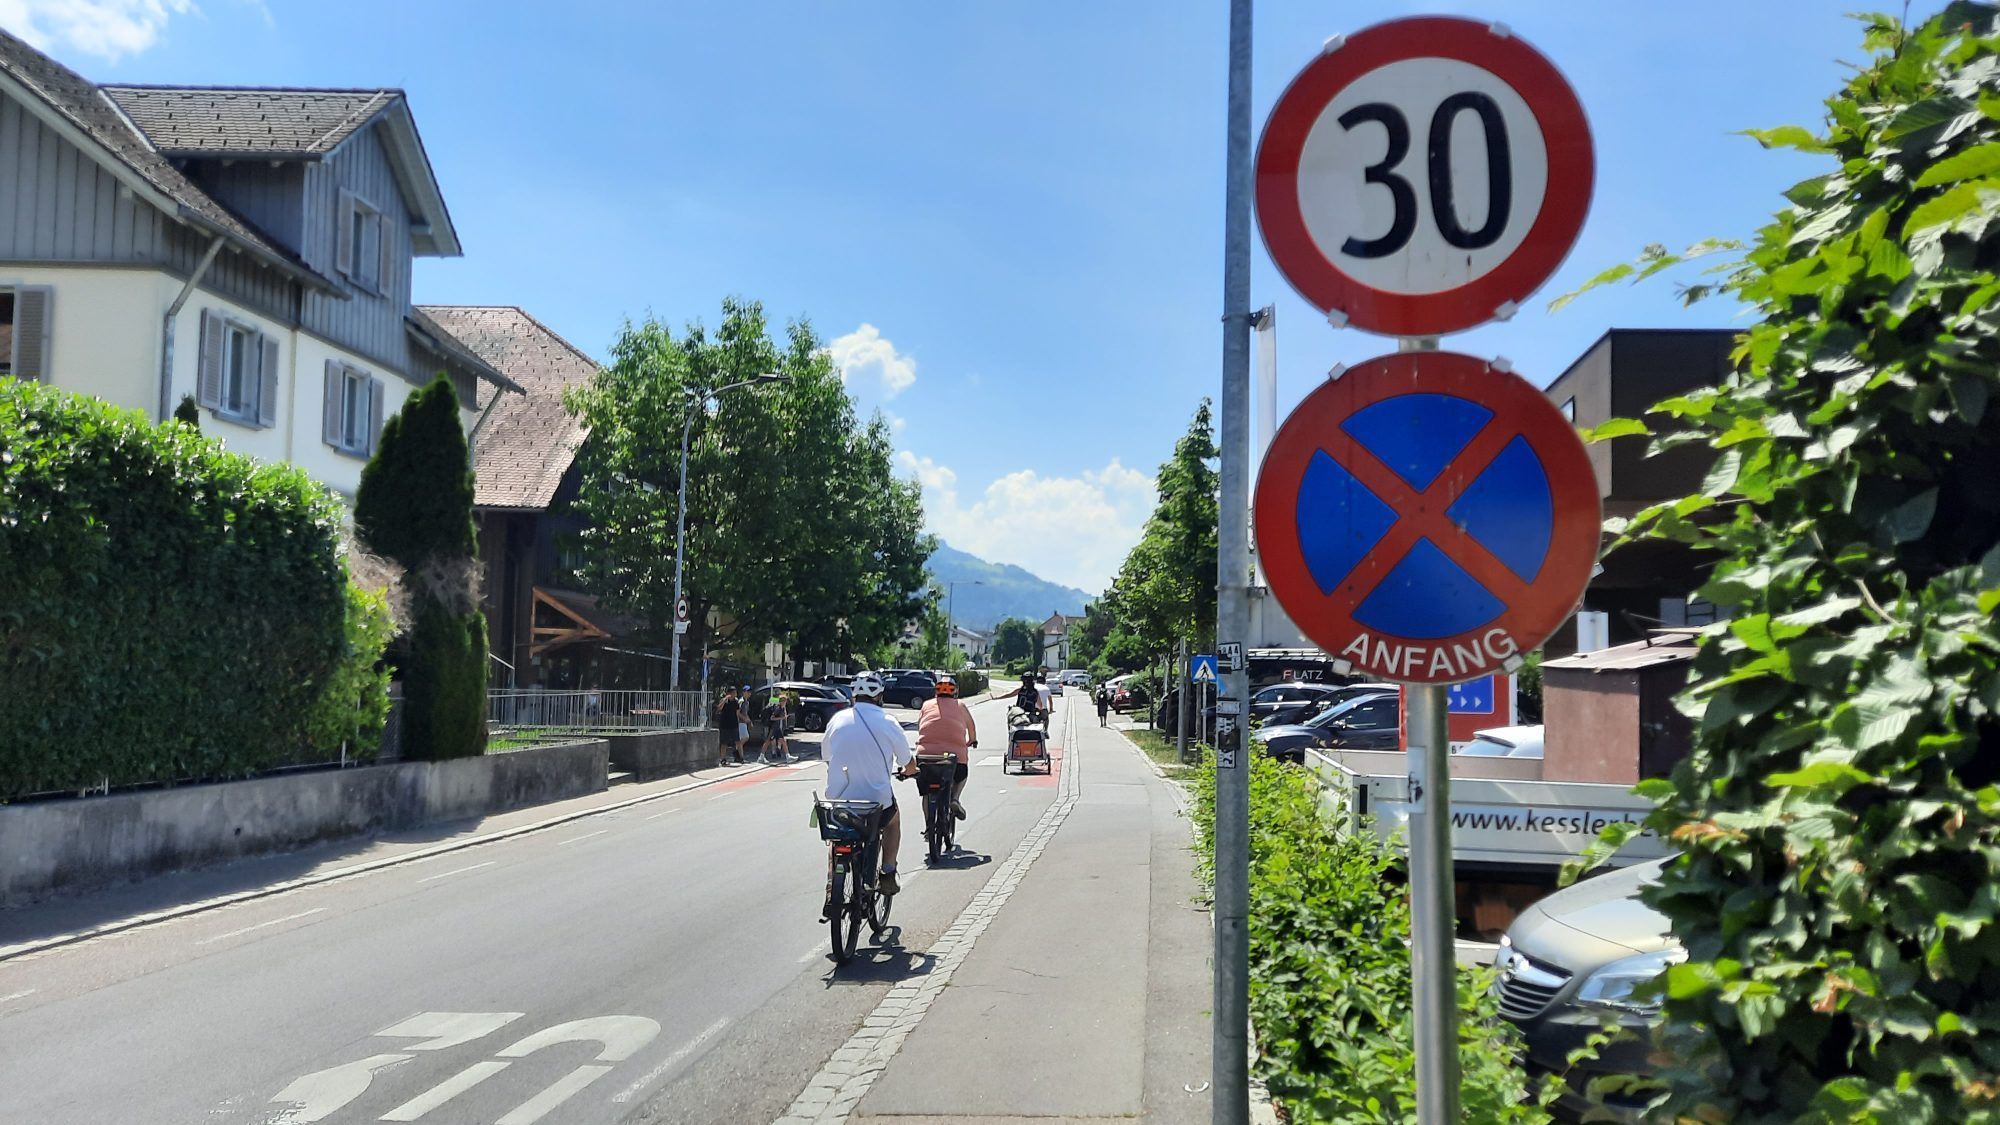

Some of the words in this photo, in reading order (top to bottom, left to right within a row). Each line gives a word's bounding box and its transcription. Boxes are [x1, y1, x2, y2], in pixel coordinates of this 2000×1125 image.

[1337, 91, 1513, 260] 30
[1282, 669, 1324, 681] FLATZ
[1341, 628, 1518, 679] ANFANG
